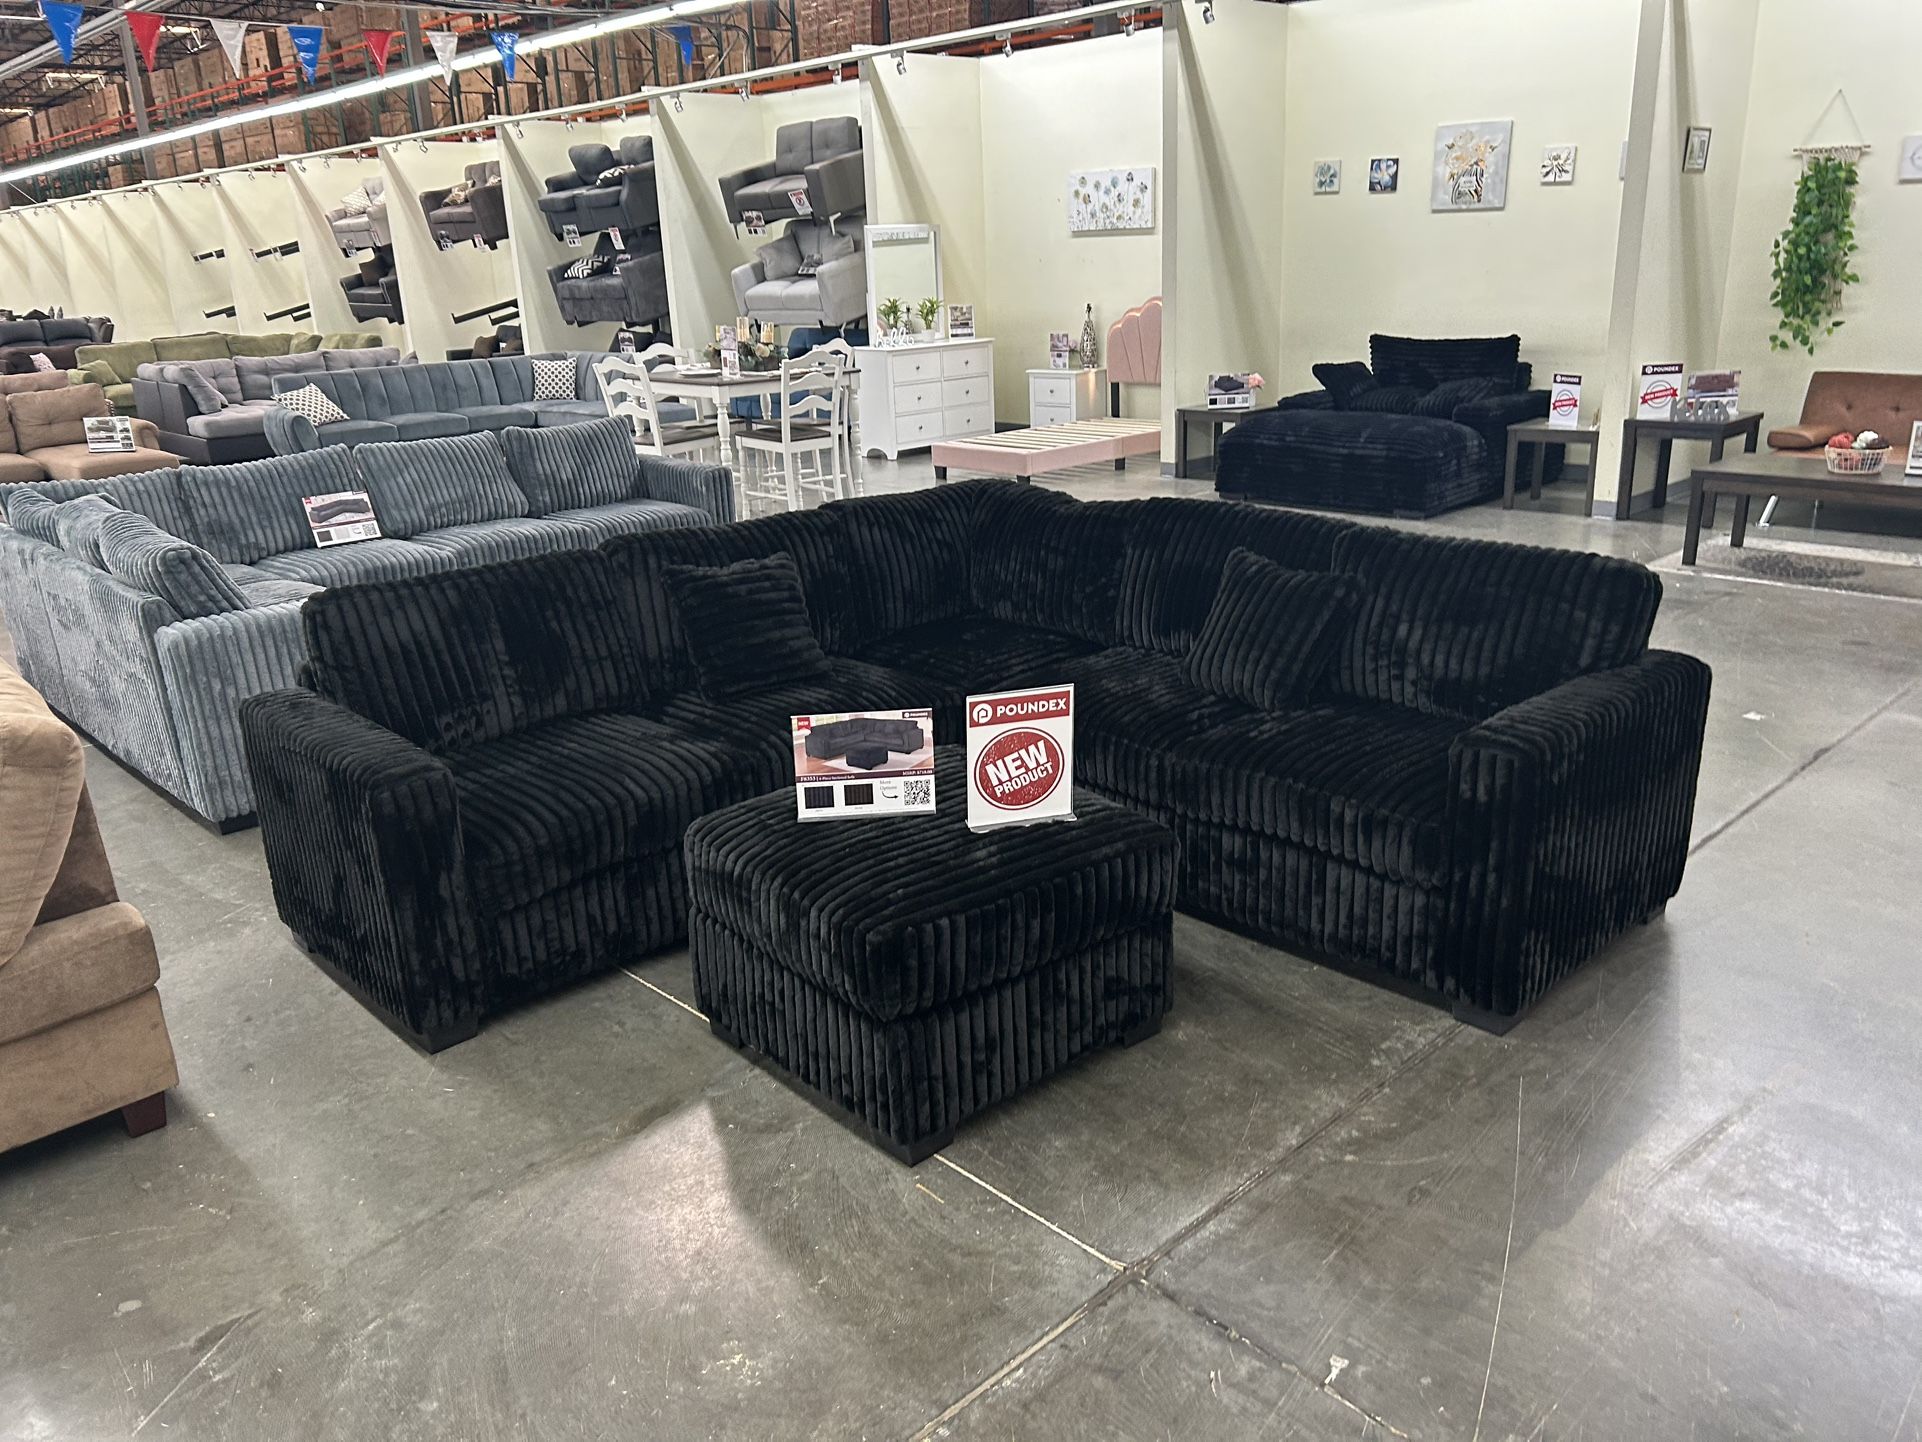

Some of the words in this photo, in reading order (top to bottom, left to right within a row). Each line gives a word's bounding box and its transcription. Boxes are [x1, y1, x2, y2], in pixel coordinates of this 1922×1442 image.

[876, 326, 914, 348] hello
[996, 698, 1067, 717] POUNDEX
[985, 739, 1049, 787] NEW
[994, 761, 1054, 798] PRODUCT
